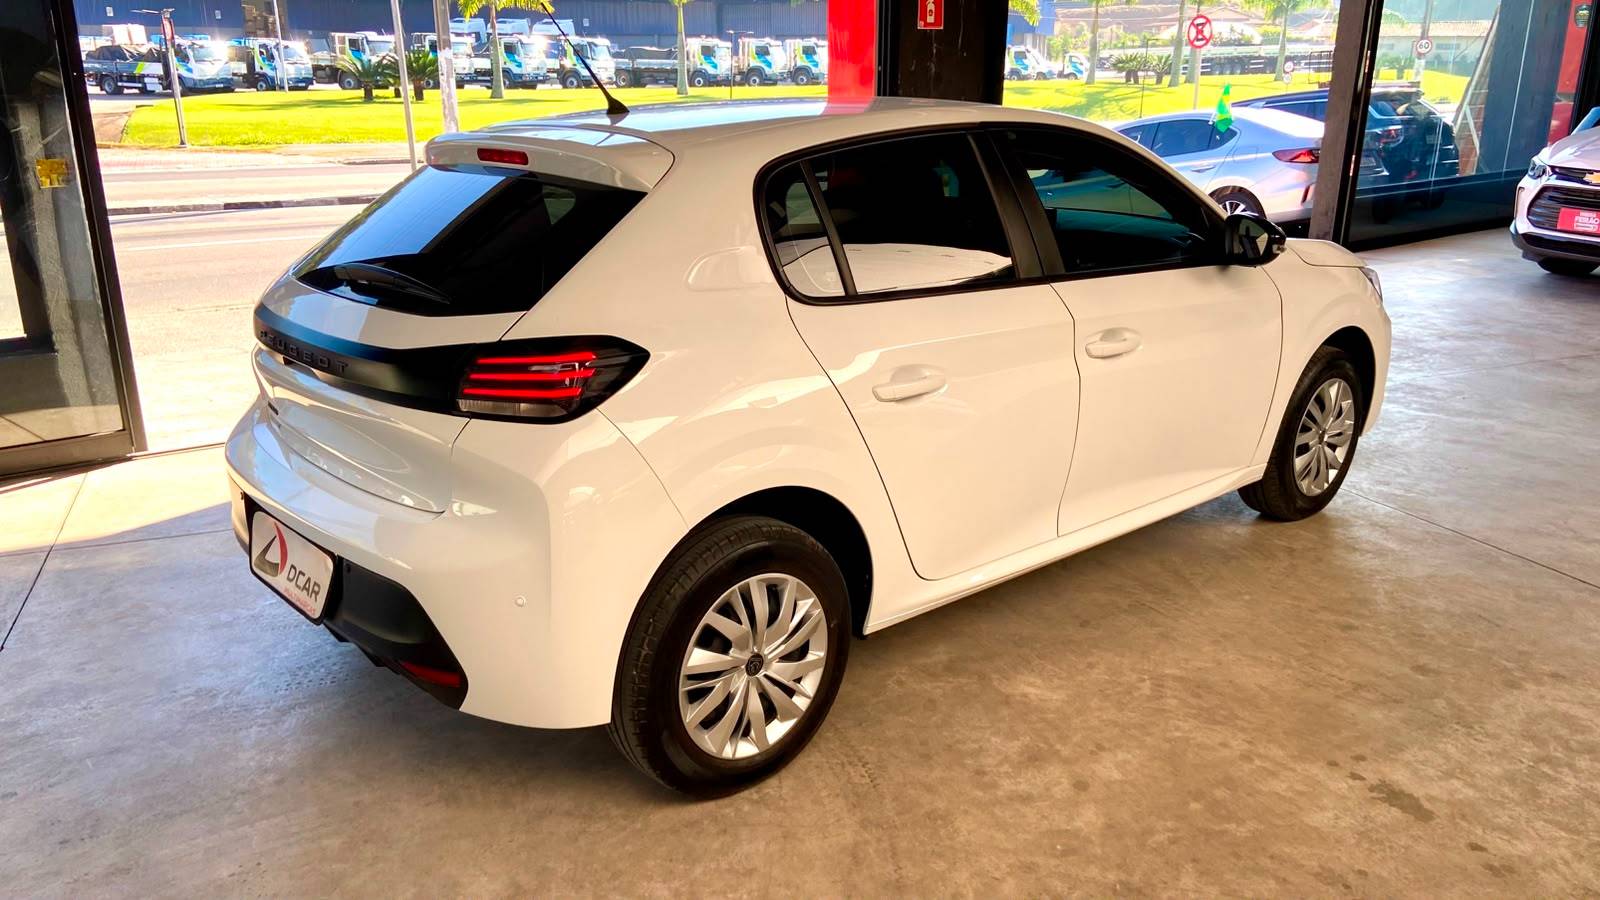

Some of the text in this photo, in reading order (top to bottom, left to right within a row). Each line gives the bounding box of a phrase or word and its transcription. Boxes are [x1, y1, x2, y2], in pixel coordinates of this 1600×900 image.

[1419, 41, 1429, 49] 60
[260, 330, 350, 375] PEUGEOT
[286, 563, 321, 603] DCAR
